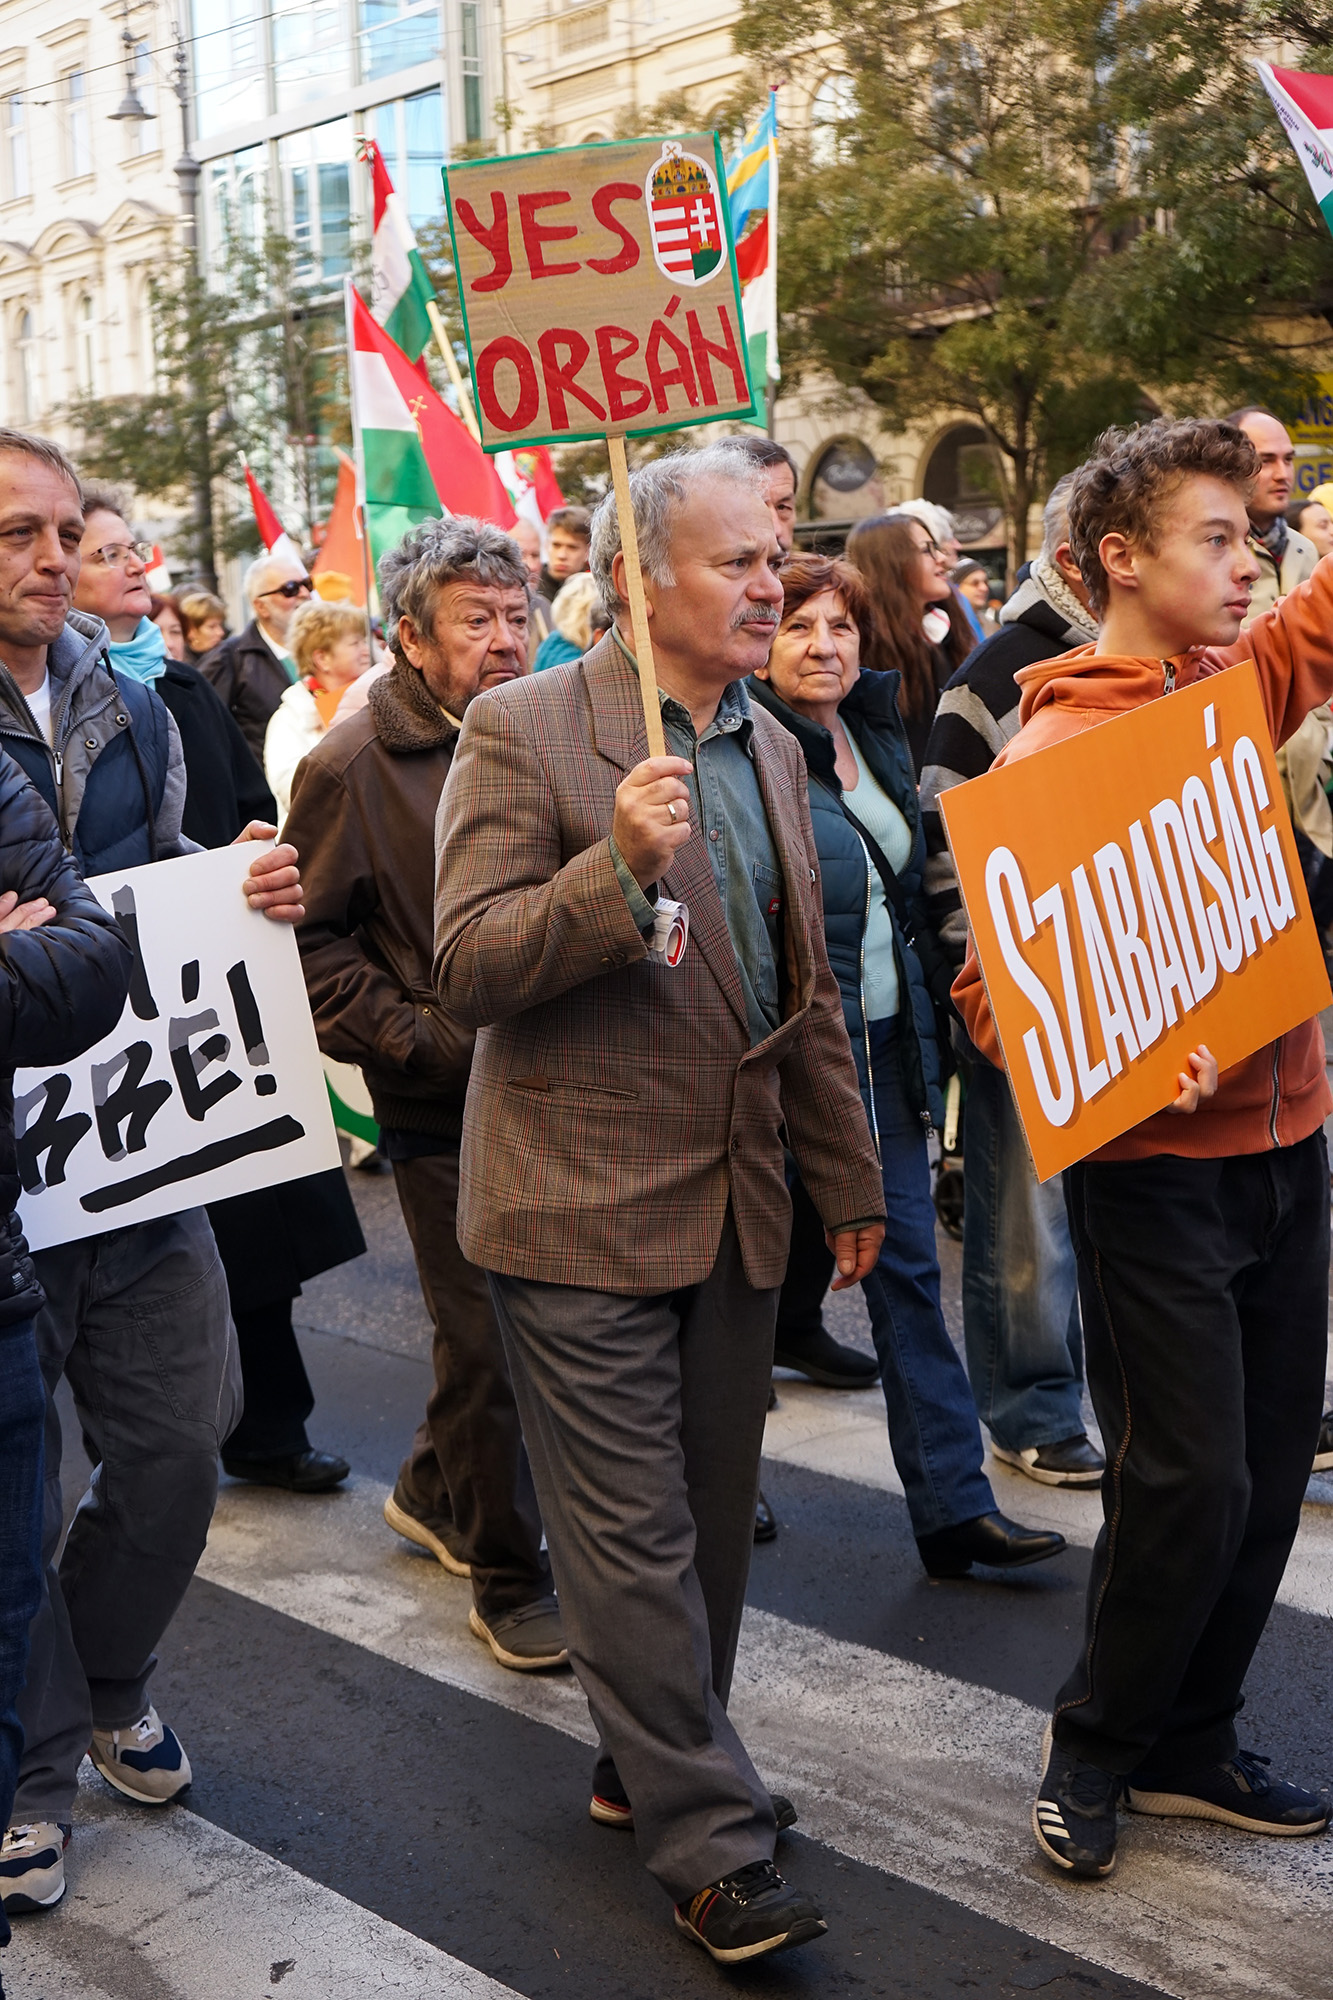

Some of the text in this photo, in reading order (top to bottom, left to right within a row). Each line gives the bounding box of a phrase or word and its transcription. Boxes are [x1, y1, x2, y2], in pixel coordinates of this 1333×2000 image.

[455, 182, 643, 292] YES
[476, 294, 750, 432] ORBÁN
[985, 703, 1297, 1127] SZABADSÁG
